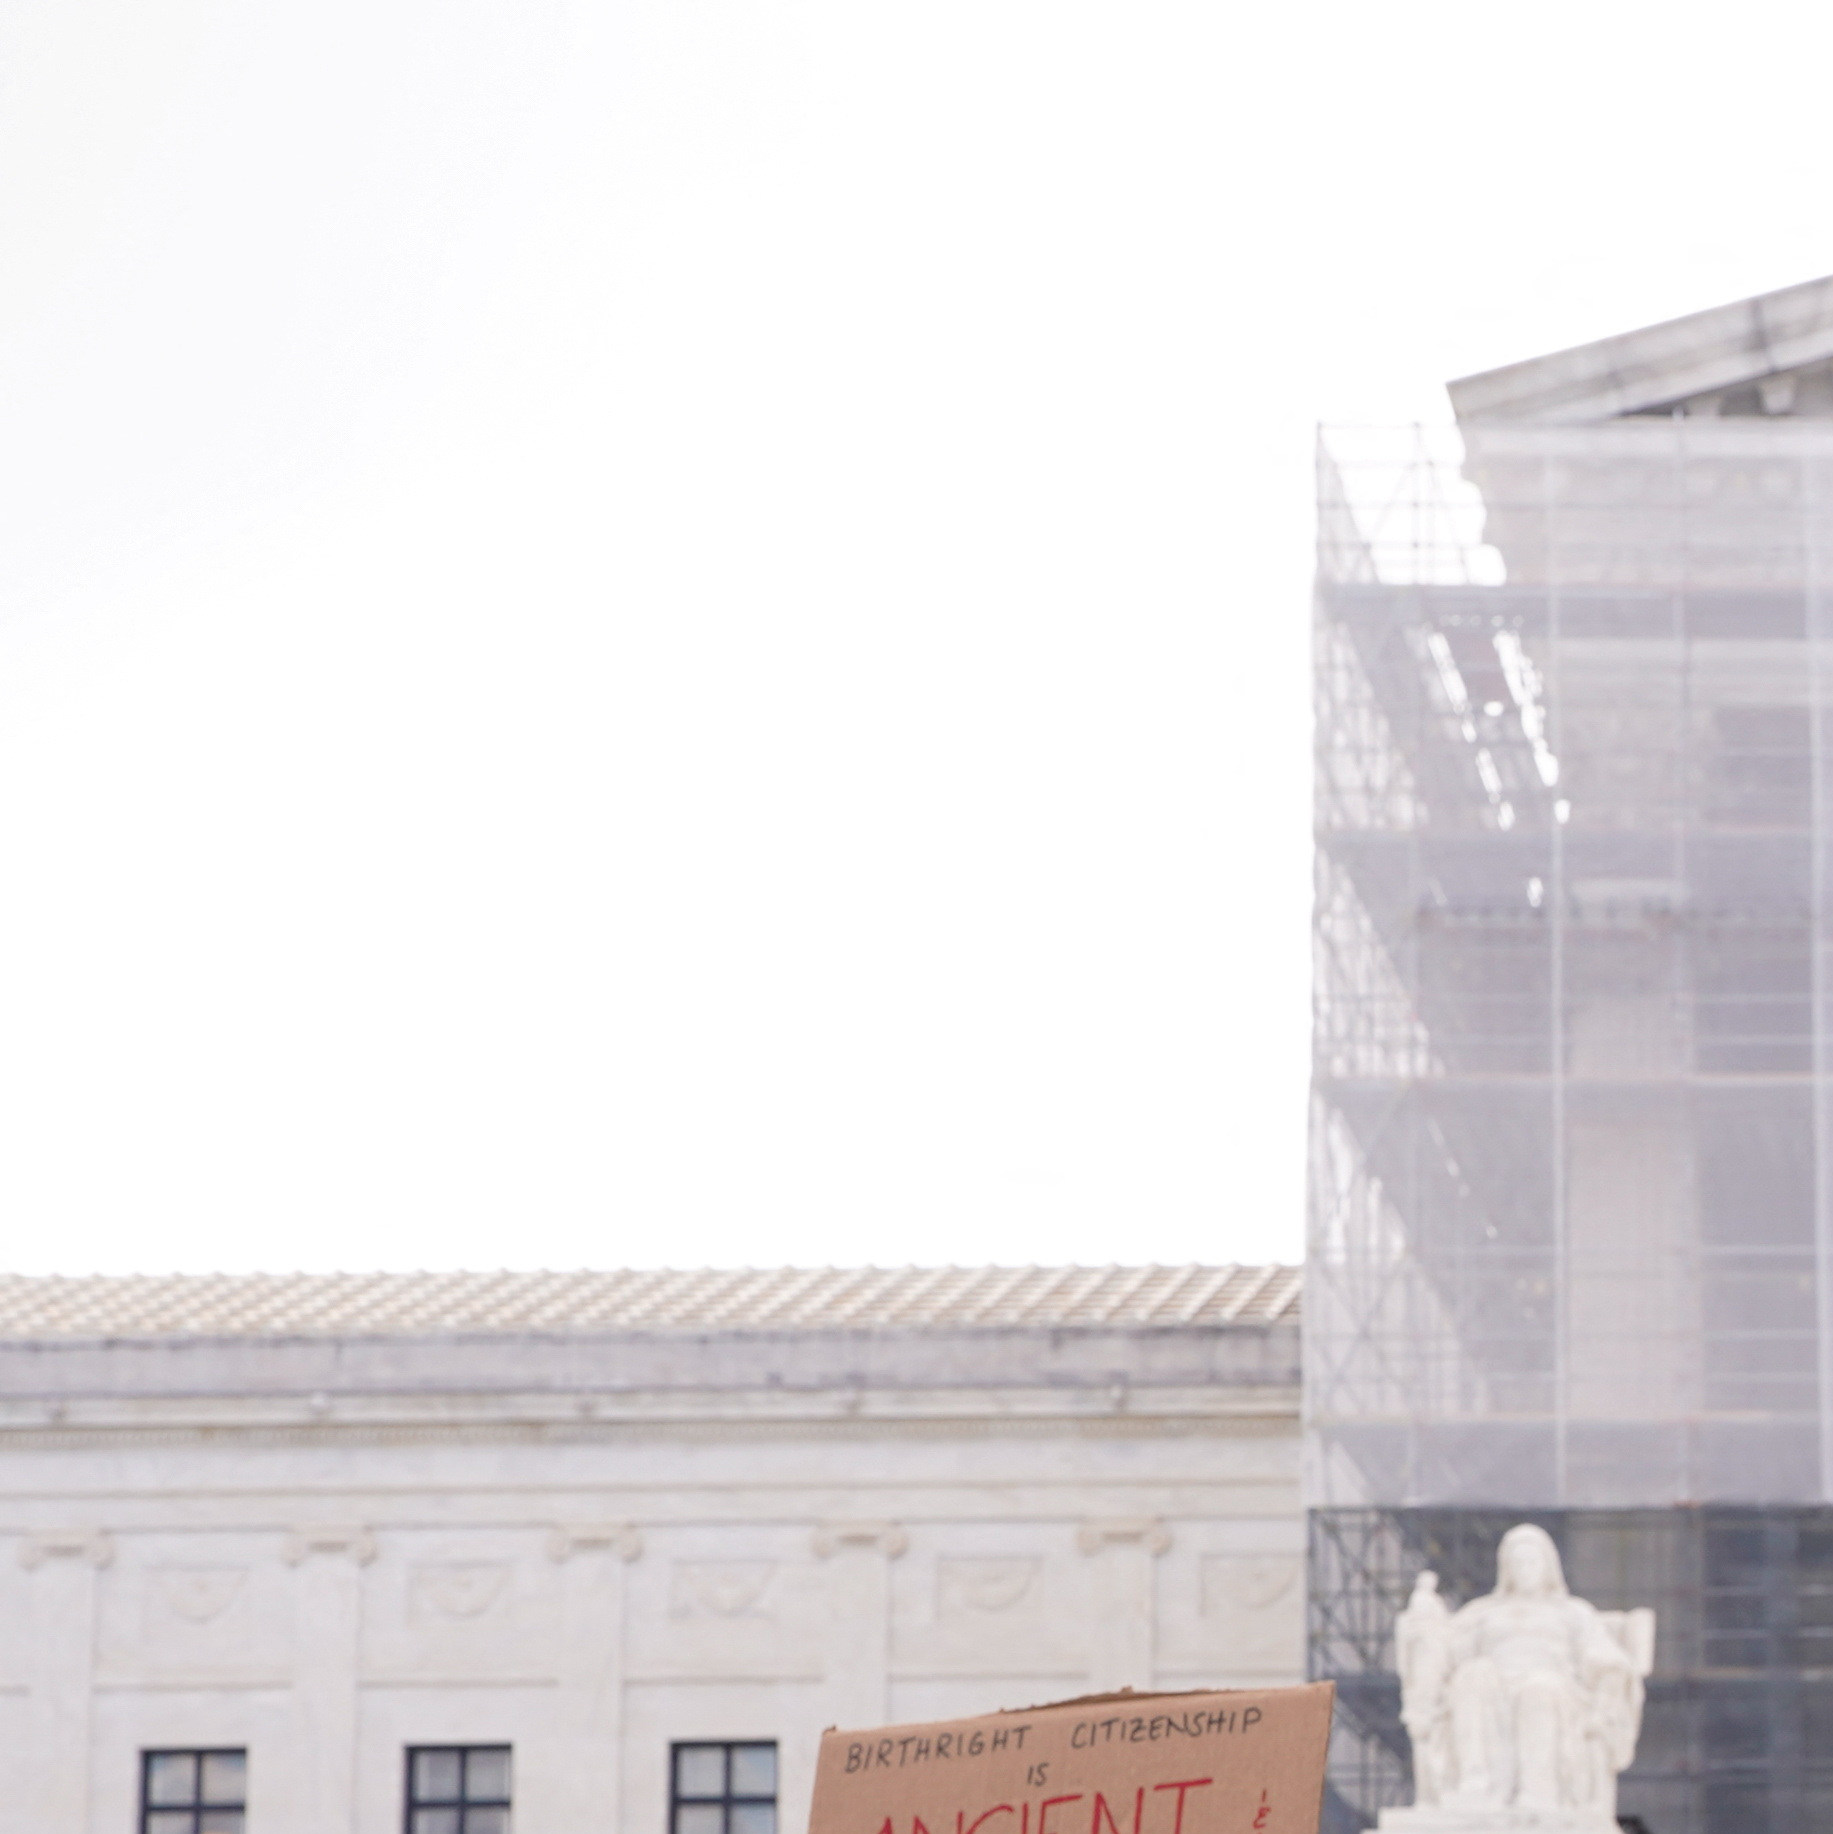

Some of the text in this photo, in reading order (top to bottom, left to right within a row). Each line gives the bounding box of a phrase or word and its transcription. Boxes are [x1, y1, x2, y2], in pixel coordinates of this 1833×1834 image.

[845, 1707, 1263, 1774] BIRTHRIGHT CITIZENSHIP
[1026, 1762, 1050, 1786] IS
